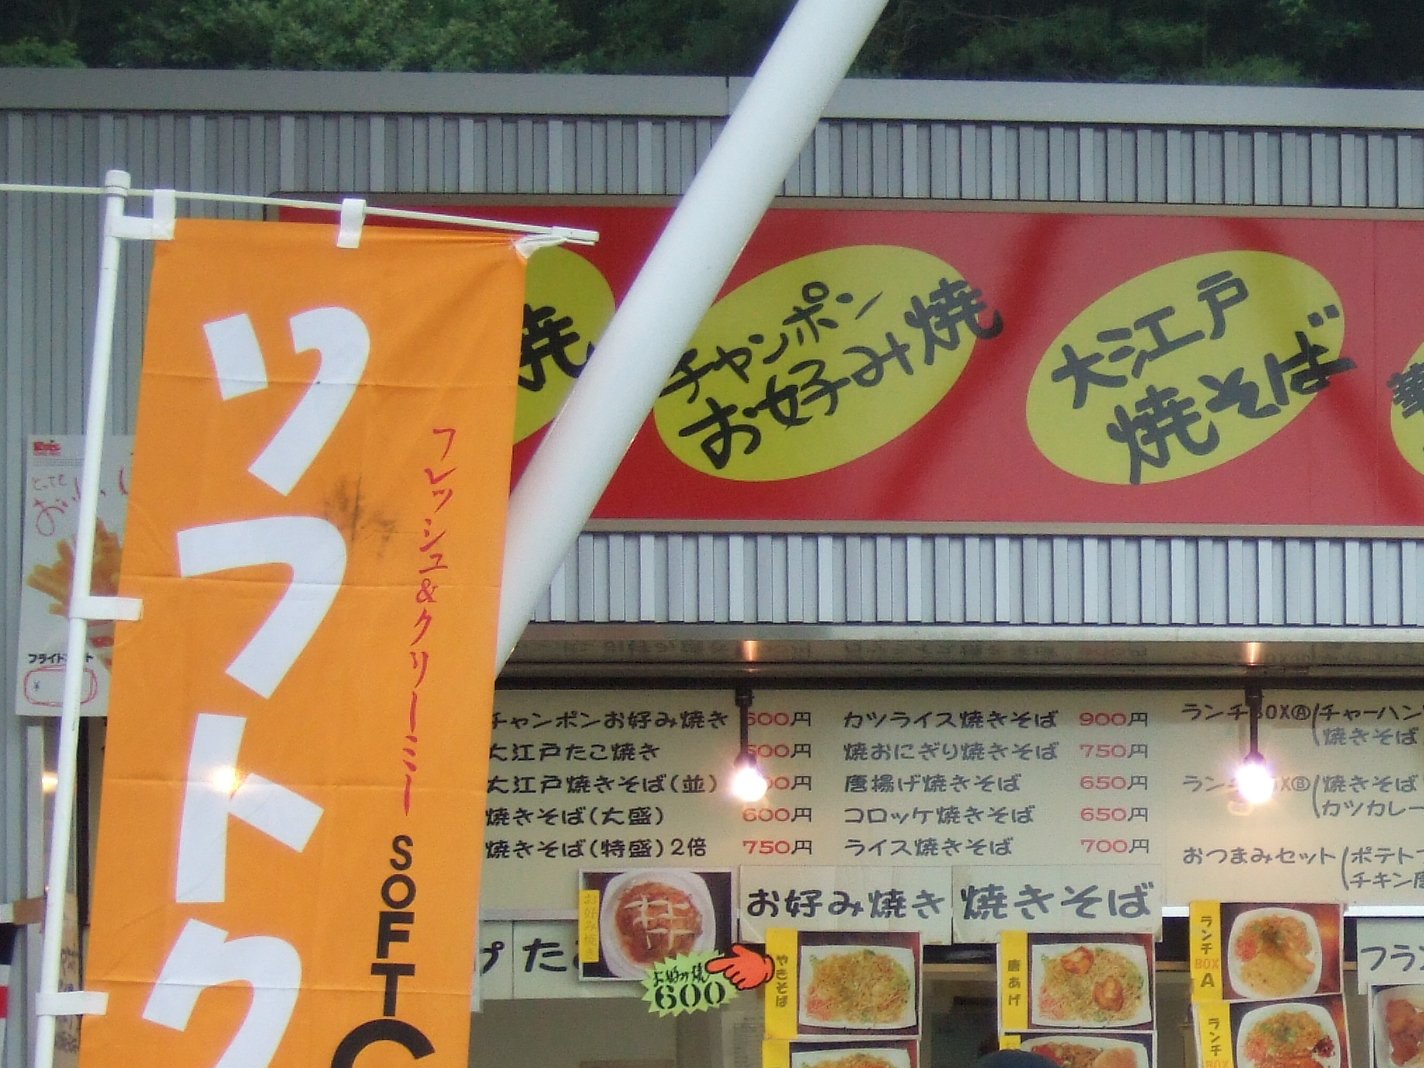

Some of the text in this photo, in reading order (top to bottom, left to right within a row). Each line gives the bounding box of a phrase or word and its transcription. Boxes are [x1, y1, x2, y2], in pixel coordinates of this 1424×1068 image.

[660, 280, 884, 404] チャンポン
[1051, 270, 1249, 410] 大江戸
[676, 277, 1003, 470] お好み焼
[1107, 304, 1358, 486] 焼そば
[843, 710, 1149, 730] カツライス焼きそば 900円
[489, 742, 661, 763] 大江戸たこ焼き
[843, 742, 1149, 763] 焼おにぎり焼きそば 750円
[487, 774, 718, 795] 大江戸焼きそば(並)
[843, 774, 1149, 794] 唐揚げ焼きそば 650円
[484, 806, 813, 828] 焼きそば(大盛) 600円
[843, 806, 1149, 827] コロッケ焼きそば 650円
[484, 838, 813, 860] 焼きそば(特盛)2倍 750円
[843, 838, 1150, 859] ライス焼きそば 700円
[1182, 847, 1337, 866] おつまみセット
[746, 886, 946, 920] お好み焼き
[961, 882, 1155, 922] 焼きそば
[370, 834, 416, 1017] SOFT
[1200, 916, 1213, 955] ランチ
[775, 953, 789, 1009] やきそば
[1200, 973, 1216, 988] A
[653, 980, 726, 1010] 600
[1207, 1018, 1222, 1057] ランチ
